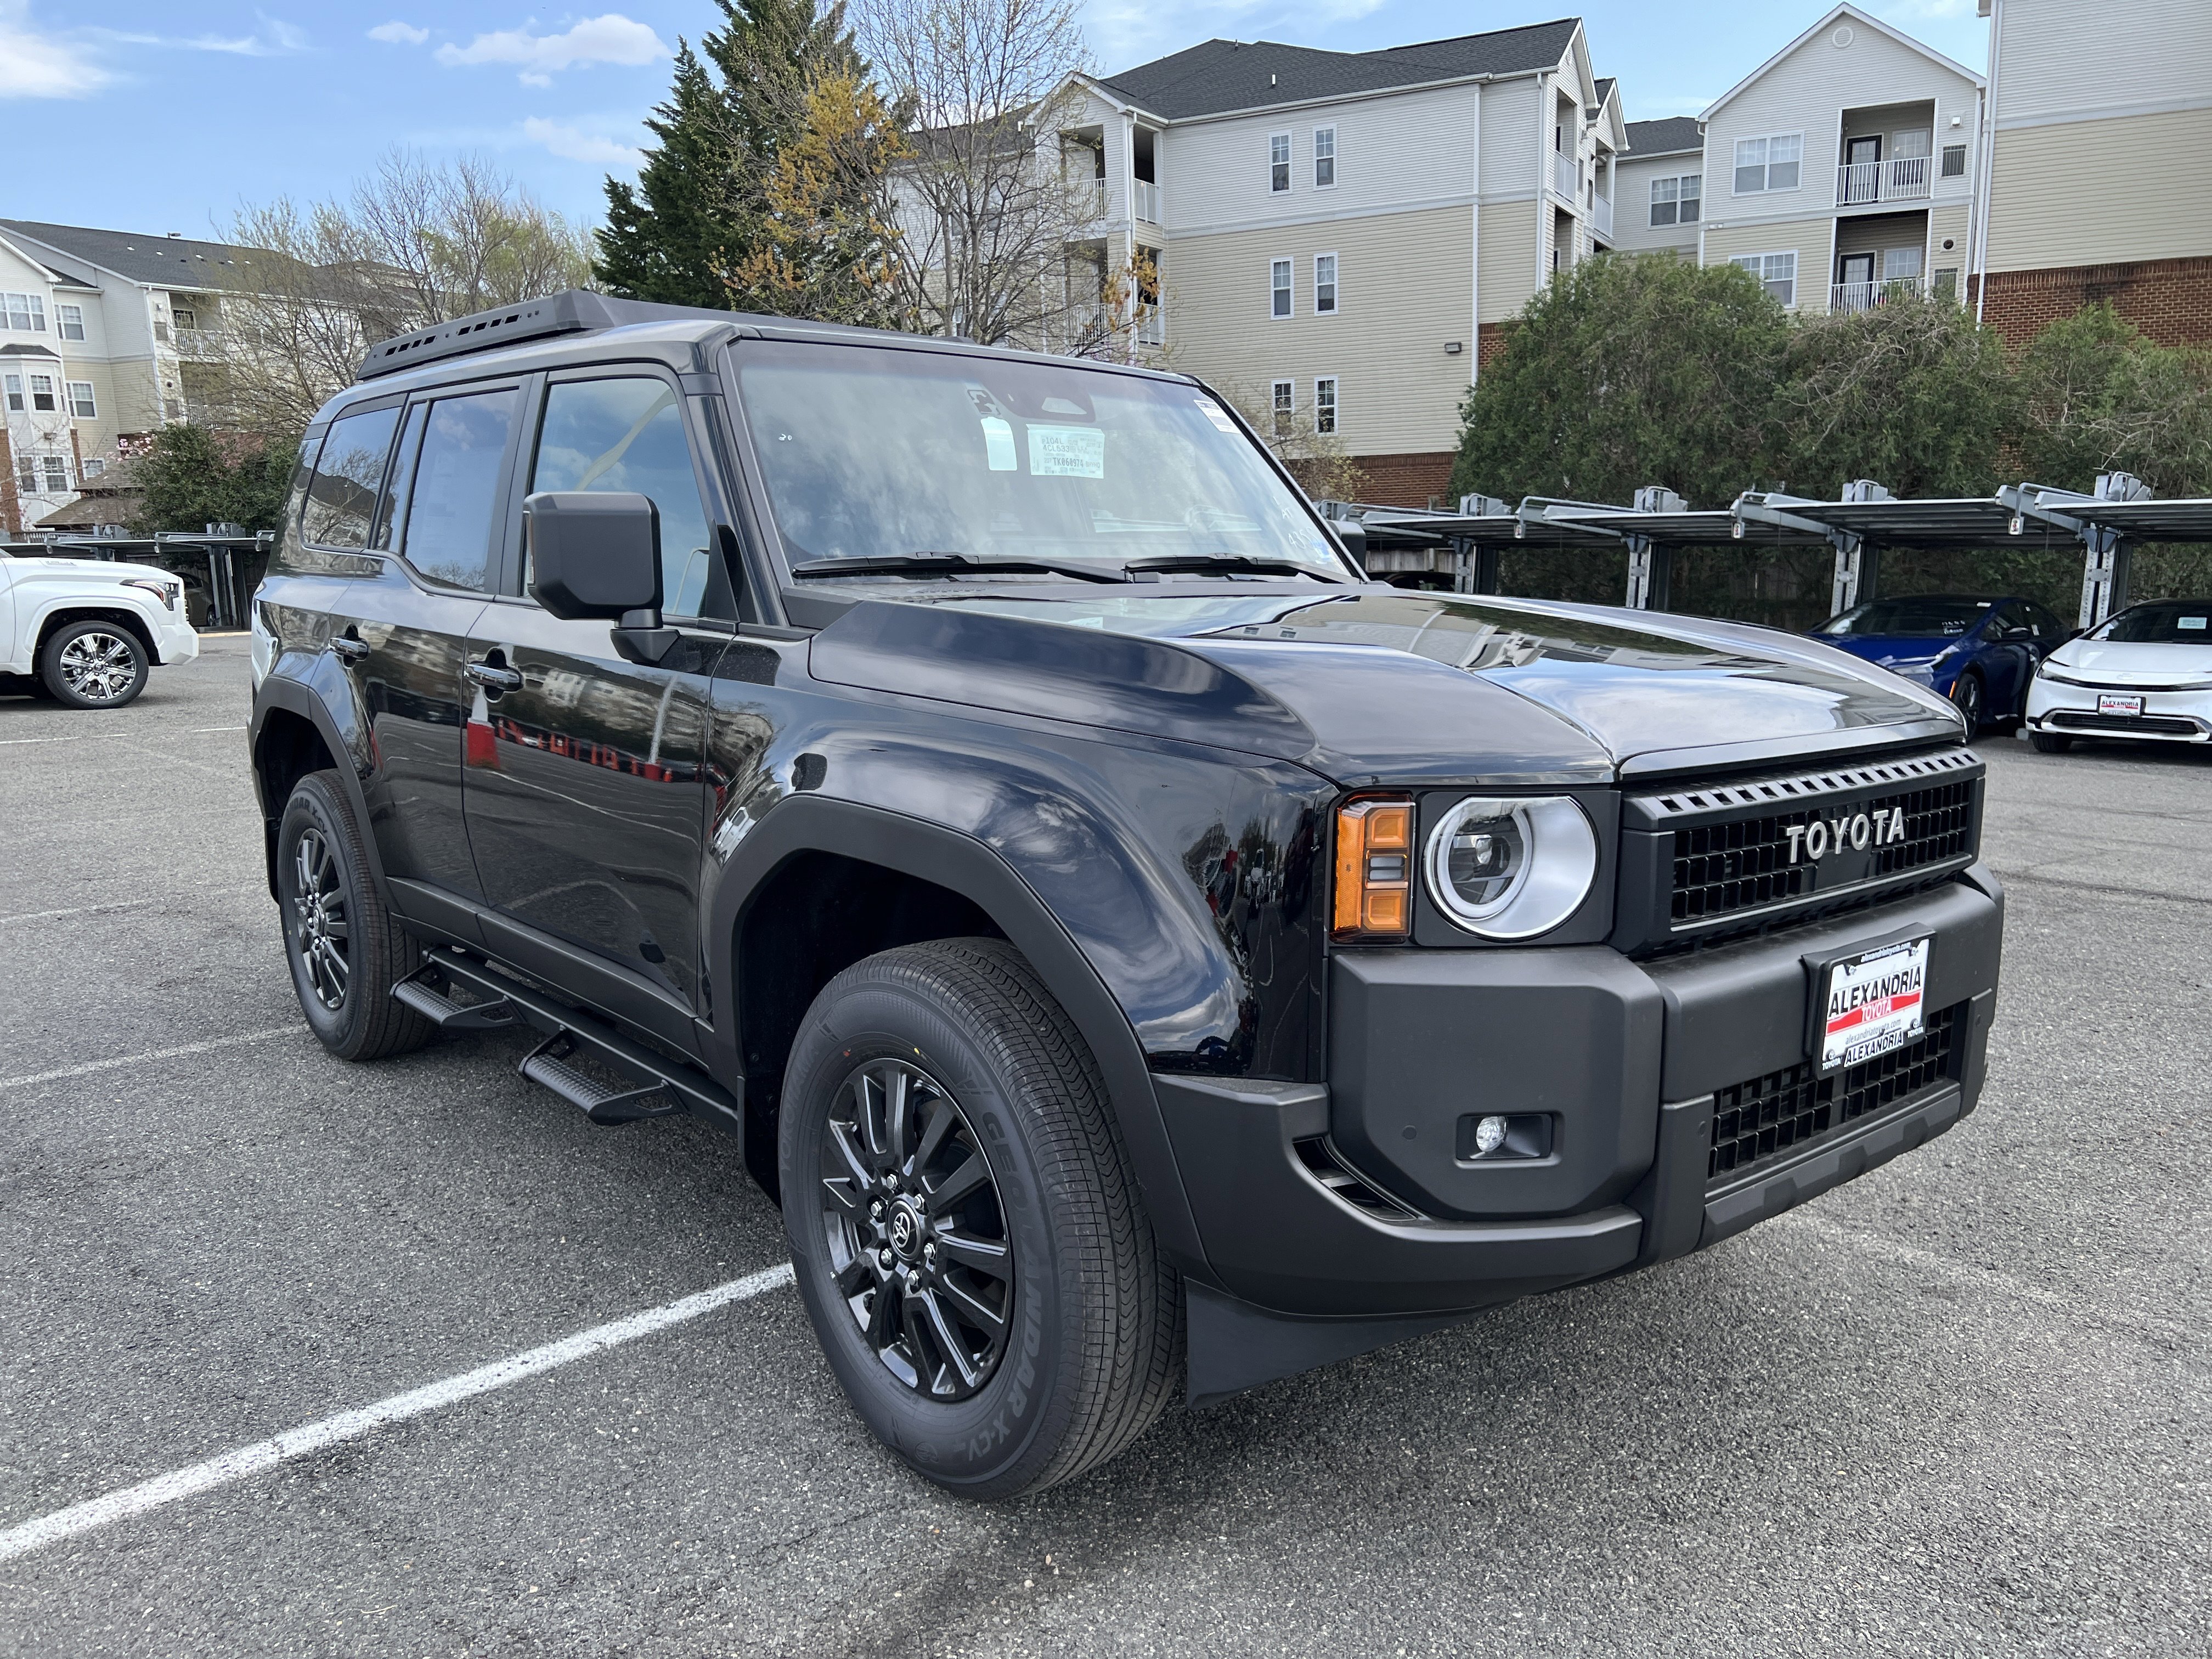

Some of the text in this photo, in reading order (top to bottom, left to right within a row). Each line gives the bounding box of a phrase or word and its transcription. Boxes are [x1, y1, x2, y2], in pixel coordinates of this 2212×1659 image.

[1787, 807, 1905, 863] TOYOTA
[1829, 966, 1921, 1018] ALEXANDRIA
[1861, 998, 1892, 1022] TOYOTA
[1845, 1019, 1901, 1045] alexandriatoyota.com
[1907, 1026, 1924, 1039] TOYOTA
[1846, 1031, 1903, 1065] ALEXANDRIA
[1822, 1056, 1841, 1070] TOYOTA
